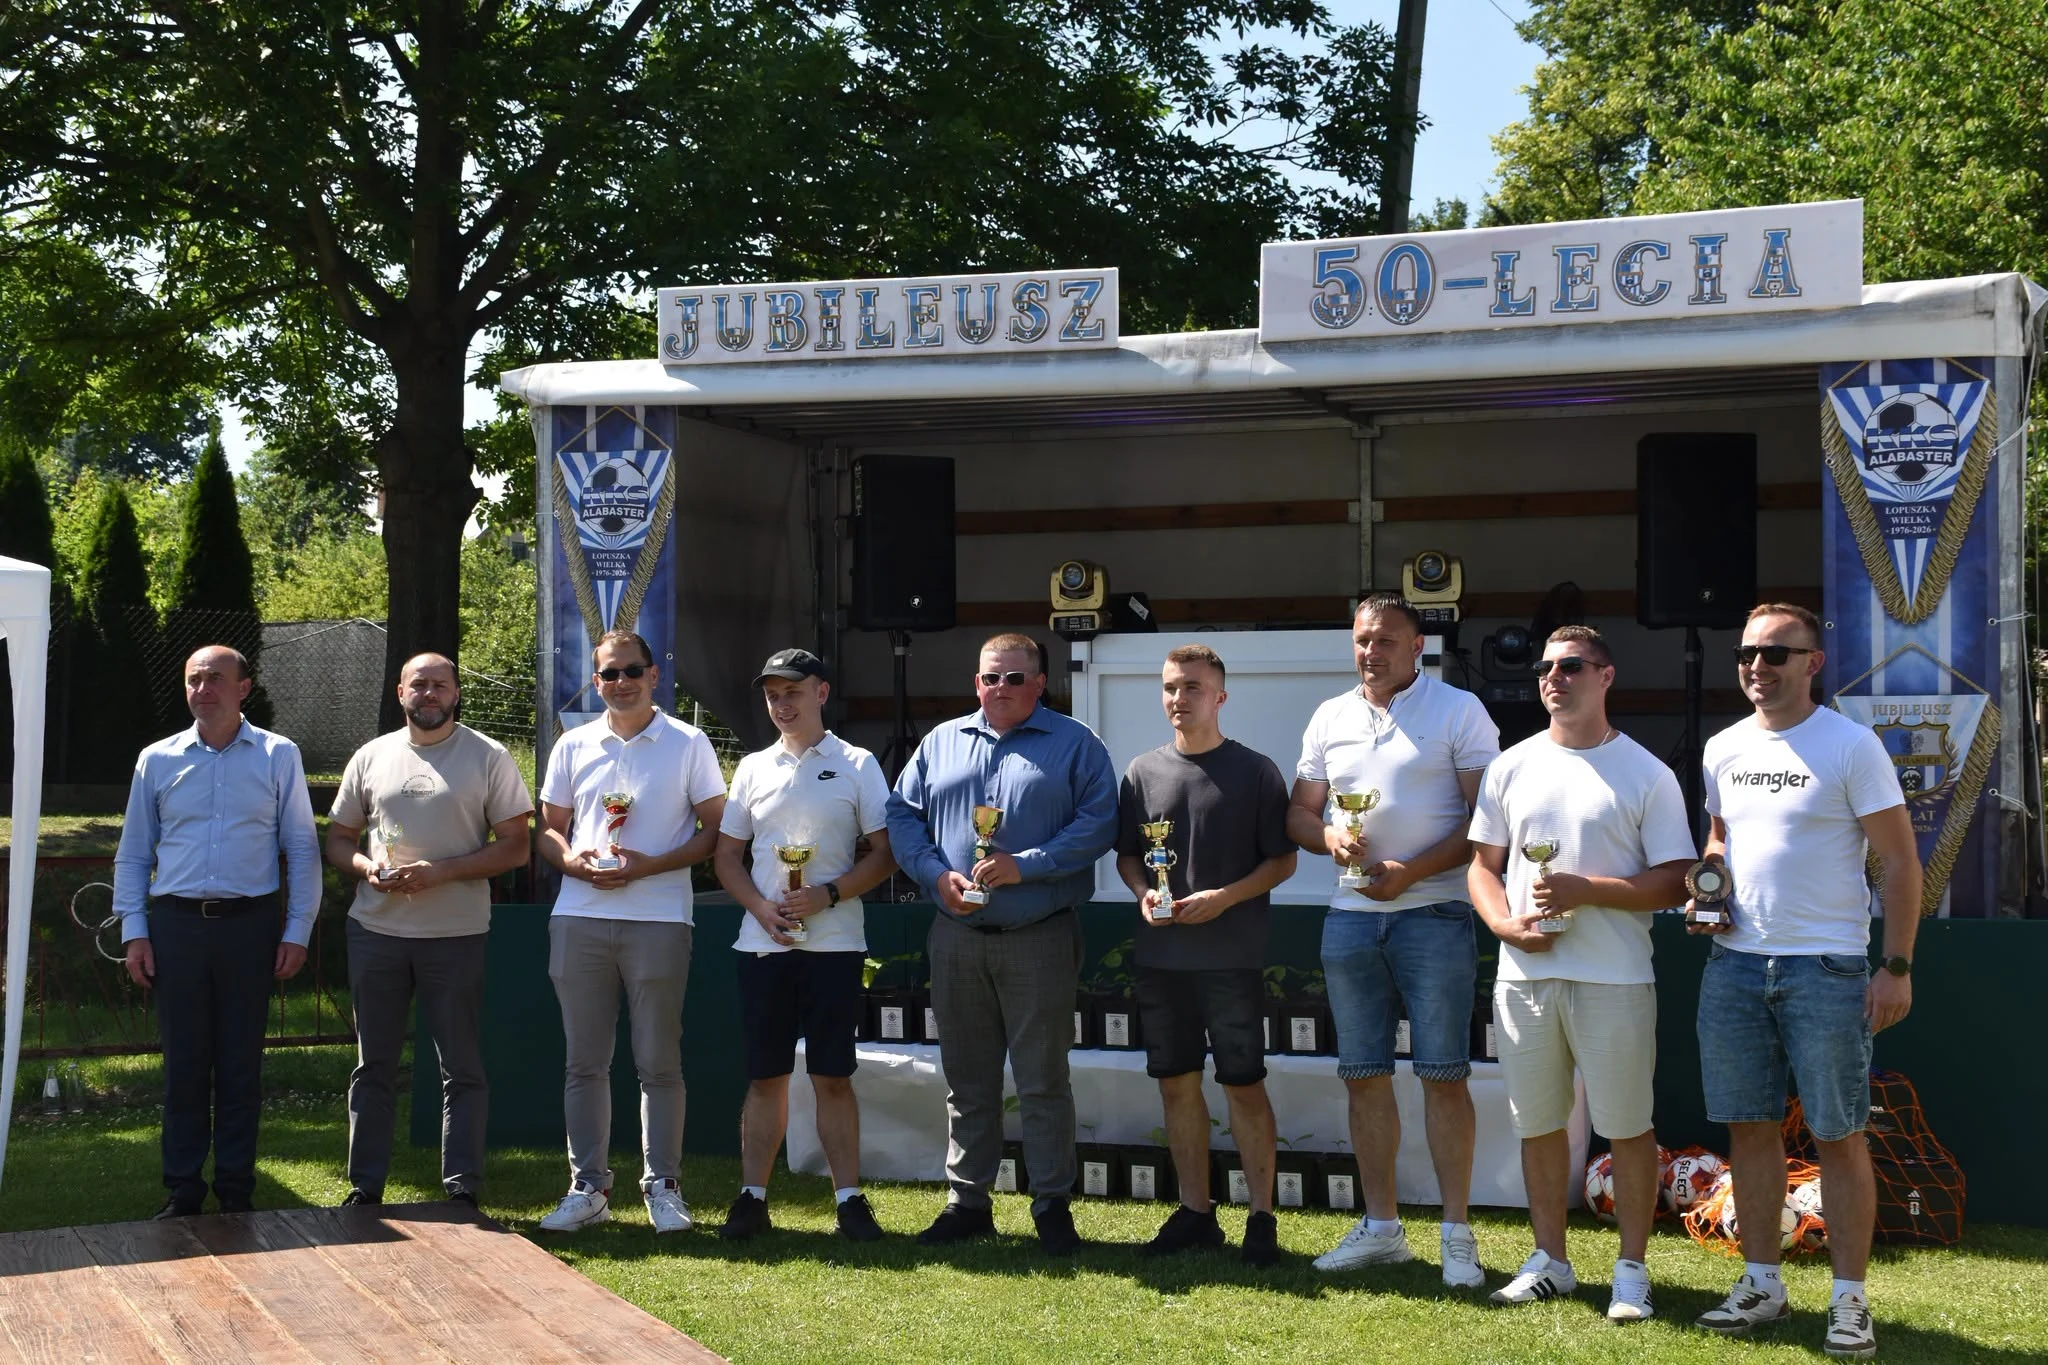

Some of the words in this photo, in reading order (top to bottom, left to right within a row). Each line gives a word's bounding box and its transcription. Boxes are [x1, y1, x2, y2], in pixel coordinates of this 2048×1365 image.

[663, 276, 1106, 361] JUBILEUSZ
[1308, 228, 1803, 330] 50-LECIA
[1866, 424, 1957, 450] KKS
[1869, 451, 1953, 466] ALABASTER
[582, 485, 650, 504] KKS
[582, 507, 645, 519] ALABASTER
[1891, 516, 1931, 524] WIELKA
[1872, 703, 1952, 718] JUBILEUSZ
[1677, 1160, 1691, 1199] SELECT
